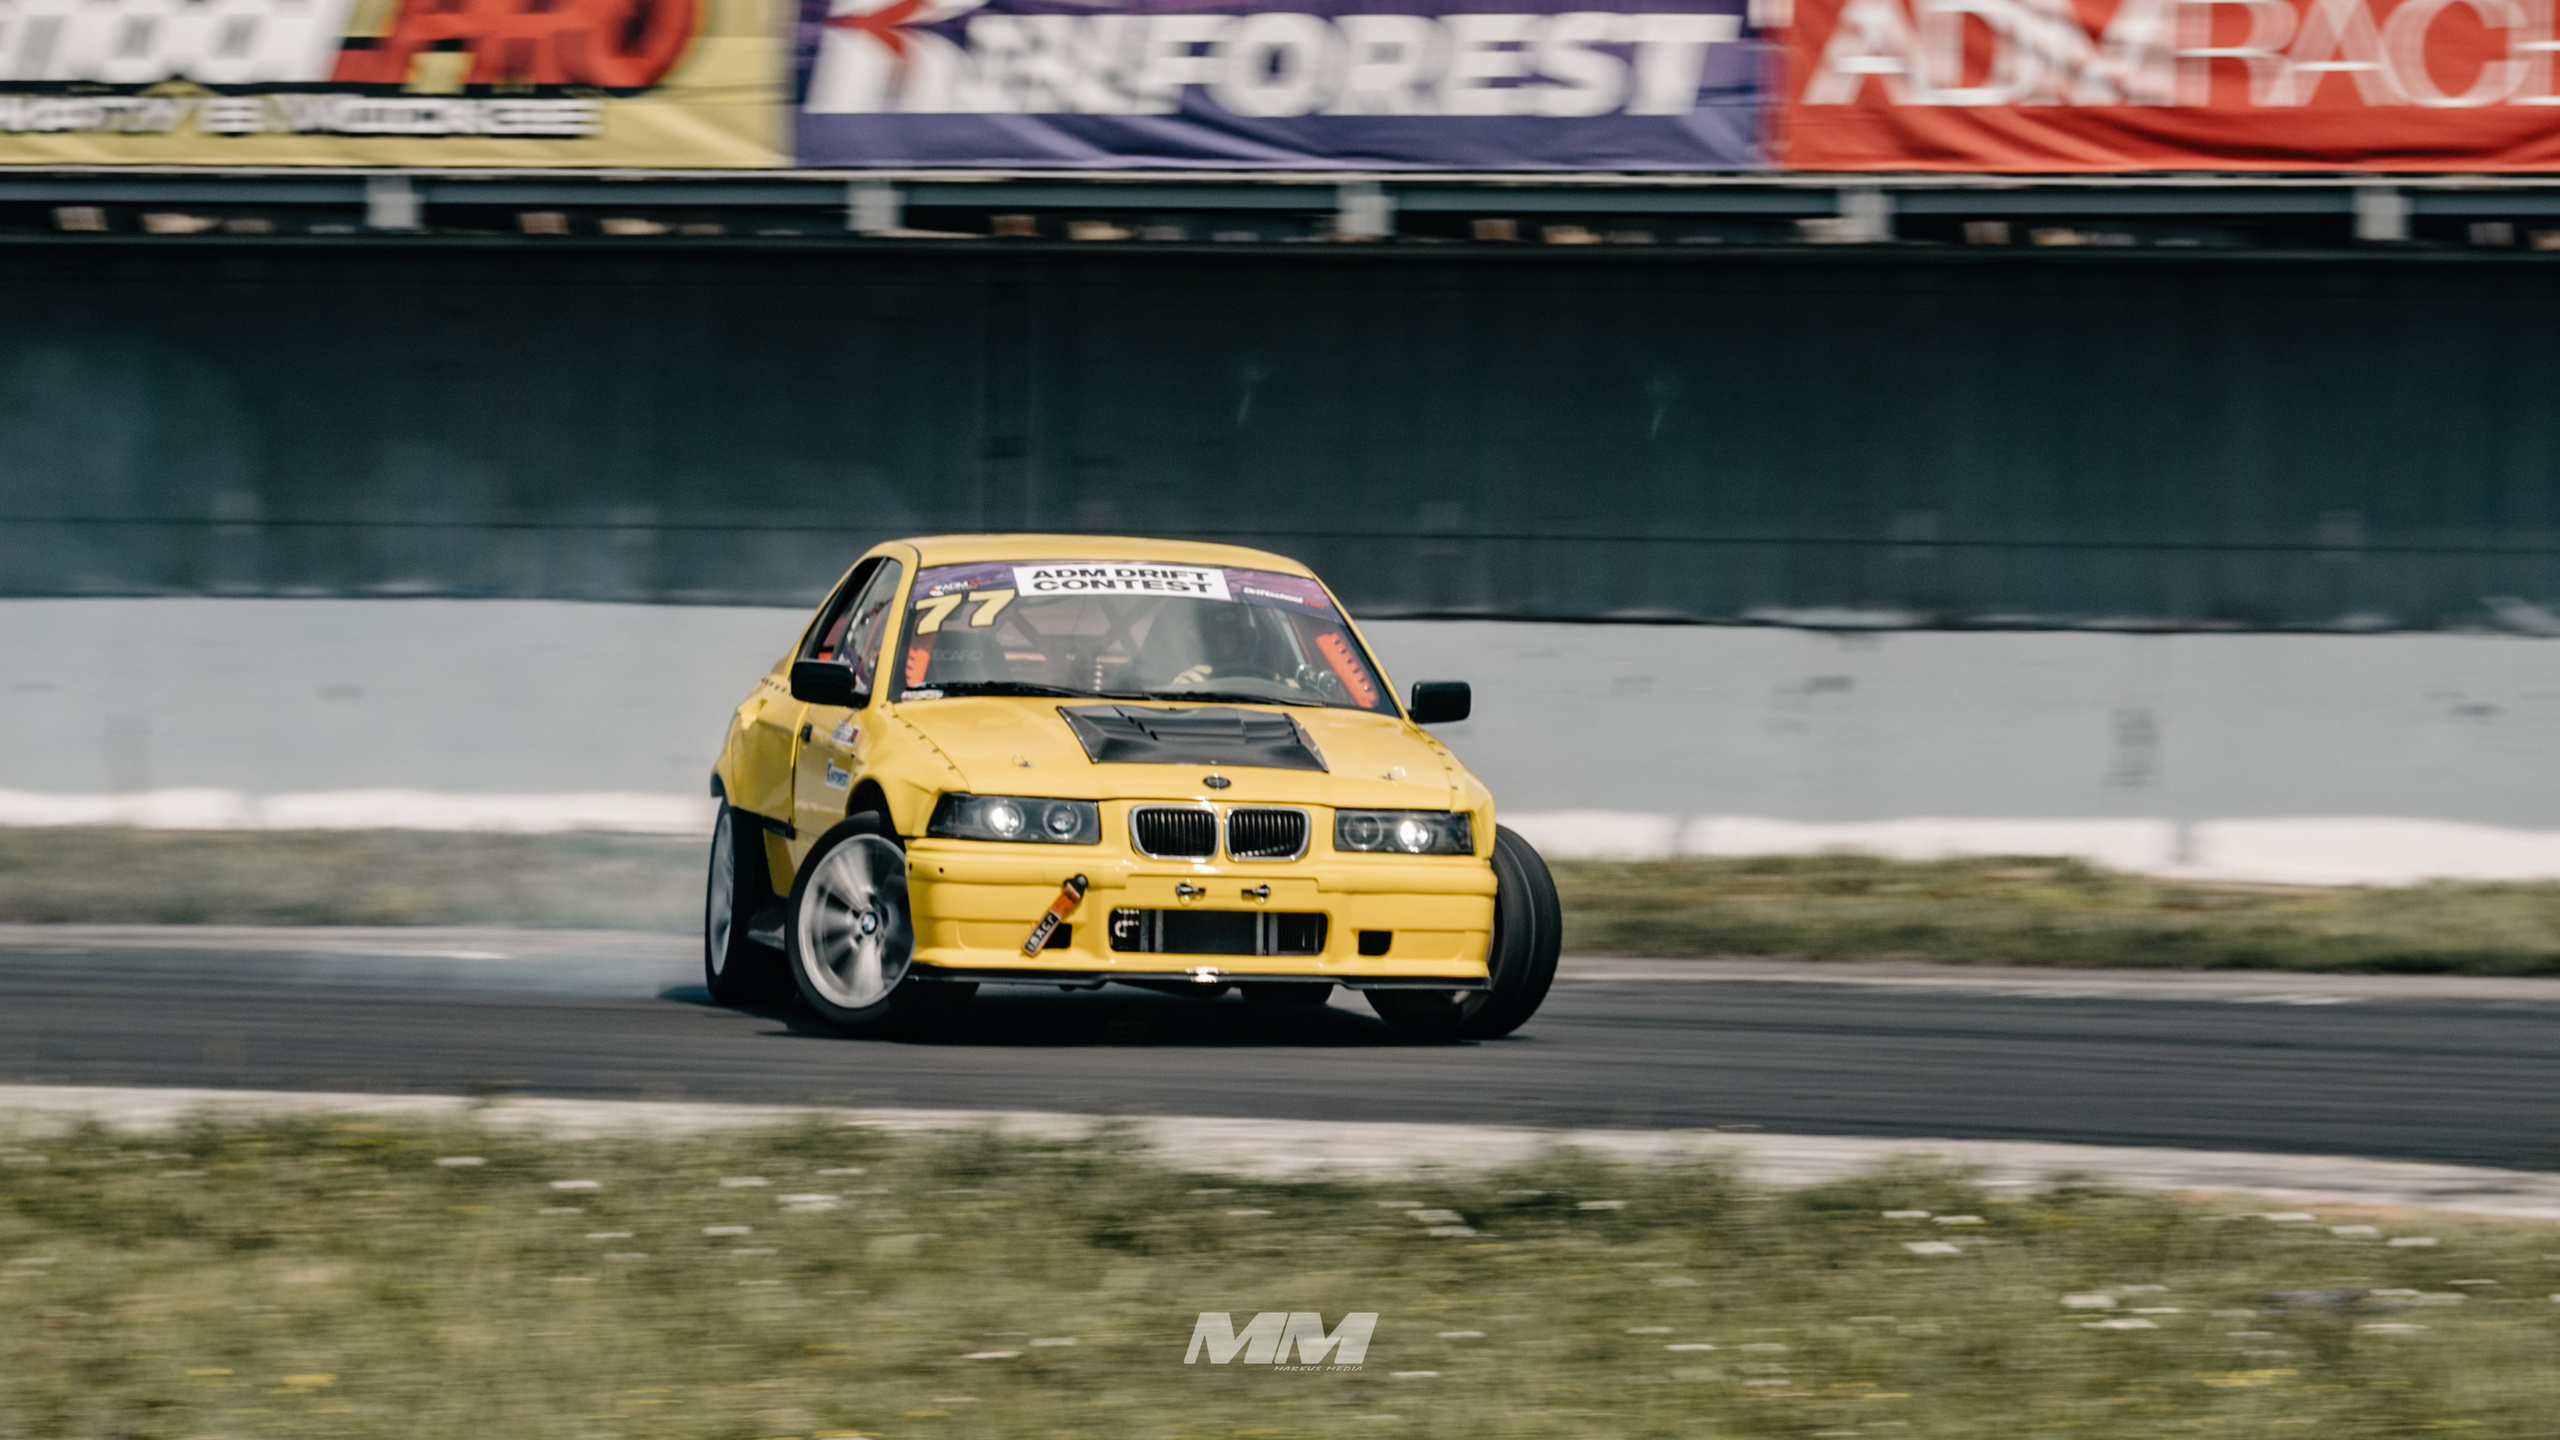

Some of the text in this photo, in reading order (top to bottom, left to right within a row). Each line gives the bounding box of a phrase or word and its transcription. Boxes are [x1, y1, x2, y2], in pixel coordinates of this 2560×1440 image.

[1032, 568, 1209, 582] ADM DRIFT
[1033, 579, 1212, 594] CONTEST
[915, 588, 1015, 636] 77
